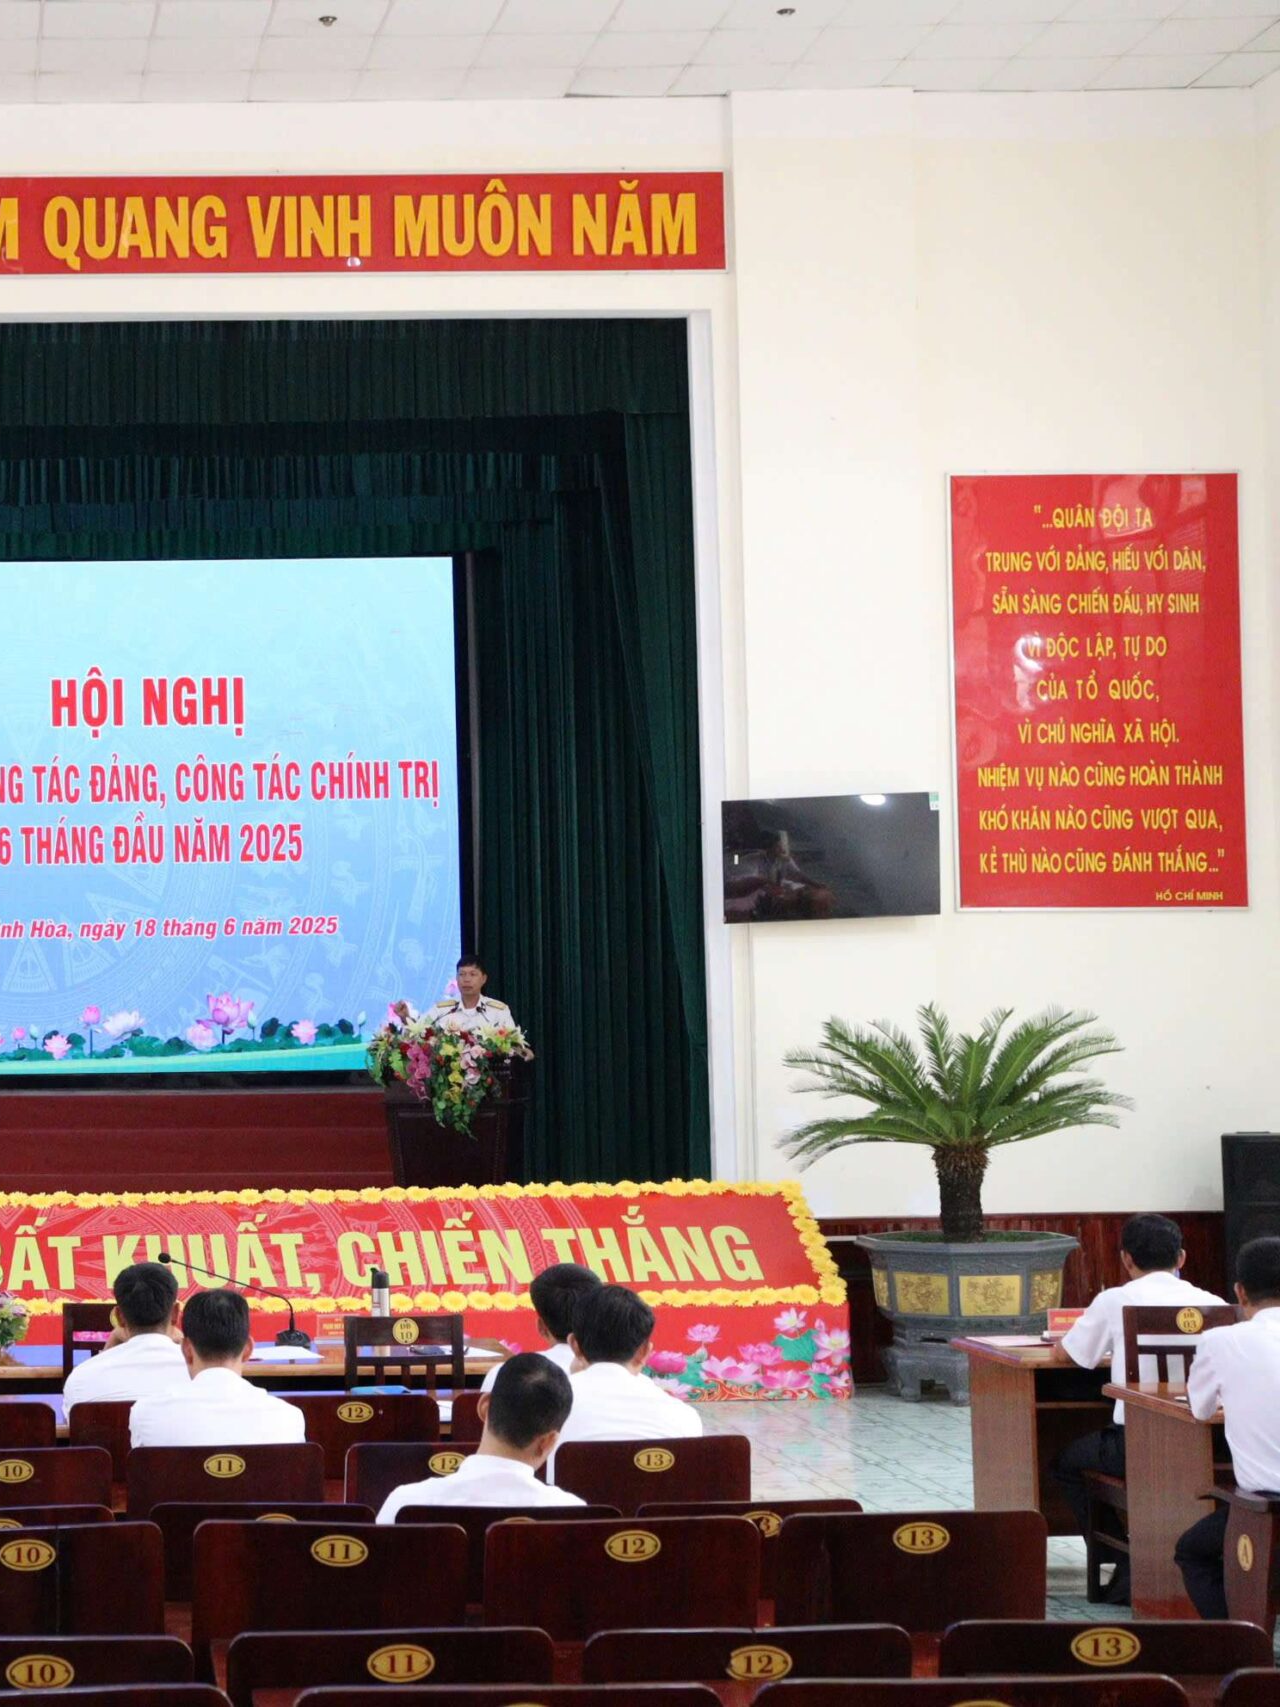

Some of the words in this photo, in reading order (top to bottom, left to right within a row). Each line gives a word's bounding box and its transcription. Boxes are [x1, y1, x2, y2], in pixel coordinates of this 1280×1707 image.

[43, 195, 227, 271] QUANG
[246, 194, 372, 259] VINH
[394, 179, 553, 257] MUÔN
[572, 179, 696, 256] NĂM
[1102, 504, 1128, 531] ĐỘI
[1136, 508, 1153, 527] TA
[986, 551, 1032, 572] TRUNG
[1036, 545, 1060, 571] VỚI
[1112, 543, 1139, 570] HIẾU
[1145, 545, 1168, 570] VỚI
[1022, 589, 1062, 614] SÀNG
[1067, 586, 1108, 614] CHIẾN
[1147, 595, 1163, 613] HY
[1168, 593, 1199, 613] SINH
[1047, 632, 1079, 660] ĐỘC
[1087, 632, 1116, 661] LẬP,
[1124, 635, 1140, 661] TỰ
[1146, 637, 1167, 656] DO
[1037, 673, 1068, 699] CỦA
[1076, 669, 1098, 699] TỔ
[51, 666, 123, 738] HỘI
[143, 677, 244, 736] NGHỊ
[1018, 718, 1032, 744] VÌ
[1037, 716, 1065, 744] CHỦ
[1070, 717, 1116, 743] NGHĨA
[1124, 718, 1143, 743] XÃ
[32, 756, 80, 804] TÁC
[89, 753, 166, 808] ĐẢNG,
[175, 754, 245, 802] CÔNG
[253, 753, 301, 801] TÁC
[311, 752, 390, 800] CHÍNH
[398, 760, 439, 808] TRỊ
[978, 763, 1019, 791] NHIỆM
[1026, 767, 1044, 791] VỤ
[1049, 760, 1080, 786] NÀO
[1084, 760, 1125, 786] CŨNG
[1130, 760, 1169, 786] HOÀN
[1175, 760, 1222, 785] THÀNH
[979, 804, 1008, 830] KHÓ
[1012, 806, 1050, 830] KHĂN
[1055, 804, 1087, 830] NÀO
[1091, 804, 1133, 829] CŨNG
[1141, 808, 1178, 834] VƯỢT
[20, 816, 104, 864] THÁNG
[113, 811, 164, 863] ĐẦU
[174, 817, 230, 863] NĂM
[240, 823, 302, 863] 2025
[980, 845, 998, 873] KẺ
[1002, 848, 1027, 873] THÙ
[1032, 847, 1062, 873] NÀO
[1065, 848, 1106, 872] CŨNG
[1112, 846, 1152, 872] ĐÁNH
[1175, 890, 1194, 901] CHÍ
[1197, 892, 1223, 900] MINH
[30, 921, 72, 941] Hòa,
[79, 921, 125, 941] ngày
[134, 919, 155, 937] 18
[163, 918, 216, 941] tháng
[223, 918, 235, 936] 6
[241, 917, 282, 936] năm
[289, 917, 338, 935] 2025
[336, 1211, 532, 1288] CHIẾN
[541, 1205, 765, 1283] THẮNG
[347, 1407, 364, 1418] 12
[3, 1466, 23, 1478] 10
[216, 1460, 233, 1472] 11
[438, 1458, 458, 1470] 12
[645, 1454, 664, 1467] 13
[620, 1539, 646, 1554] 12
[909, 1530, 934, 1546] 13
[13, 1548, 40, 1563] 10
[328, 1543, 351, 1559] 11
[1091, 1638, 1122, 1656] 13
[24, 1665, 55, 1683] 10
[387, 1655, 415, 1672] 11
[744, 1656, 773, 1673] 12
